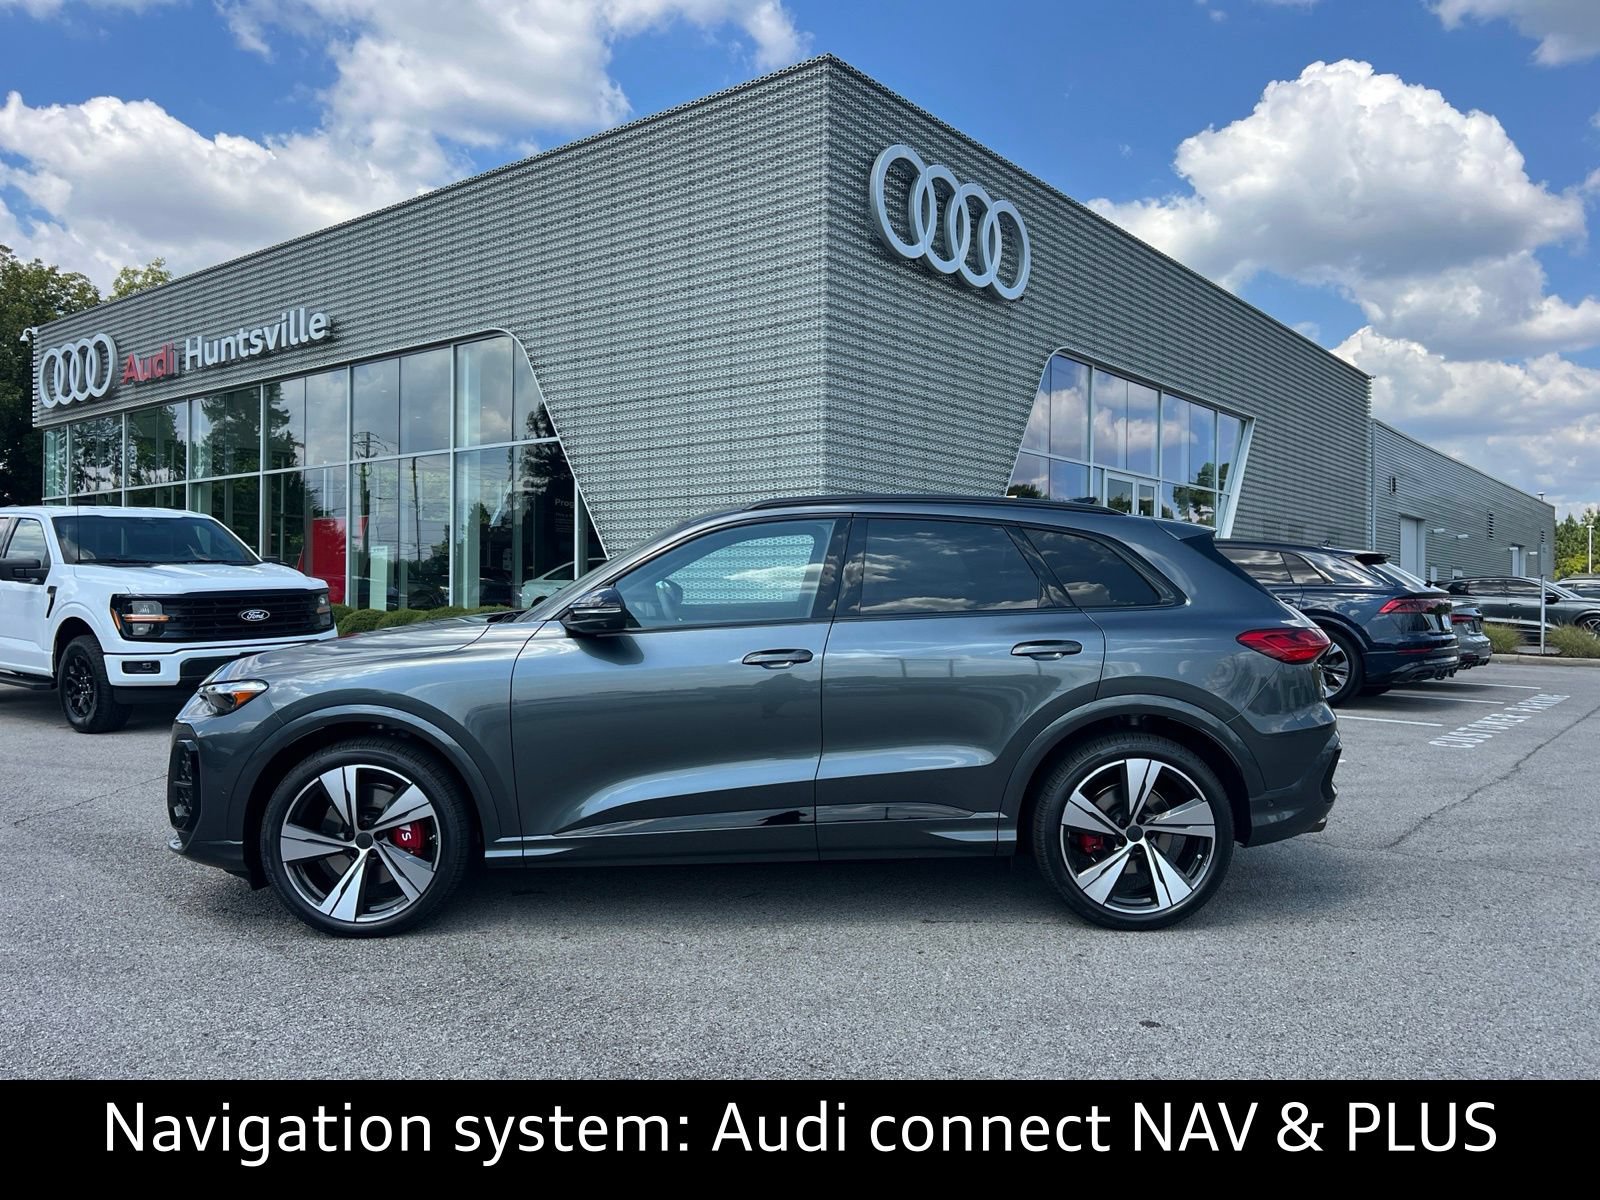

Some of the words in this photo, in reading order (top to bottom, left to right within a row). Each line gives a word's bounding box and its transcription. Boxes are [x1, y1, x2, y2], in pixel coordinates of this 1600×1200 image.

[121, 338, 178, 384] Audi
[185, 307, 333, 371] Huntsville
[243, 610, 267, 621] Ford
[1428, 713, 1532, 748] CUSTOMER
